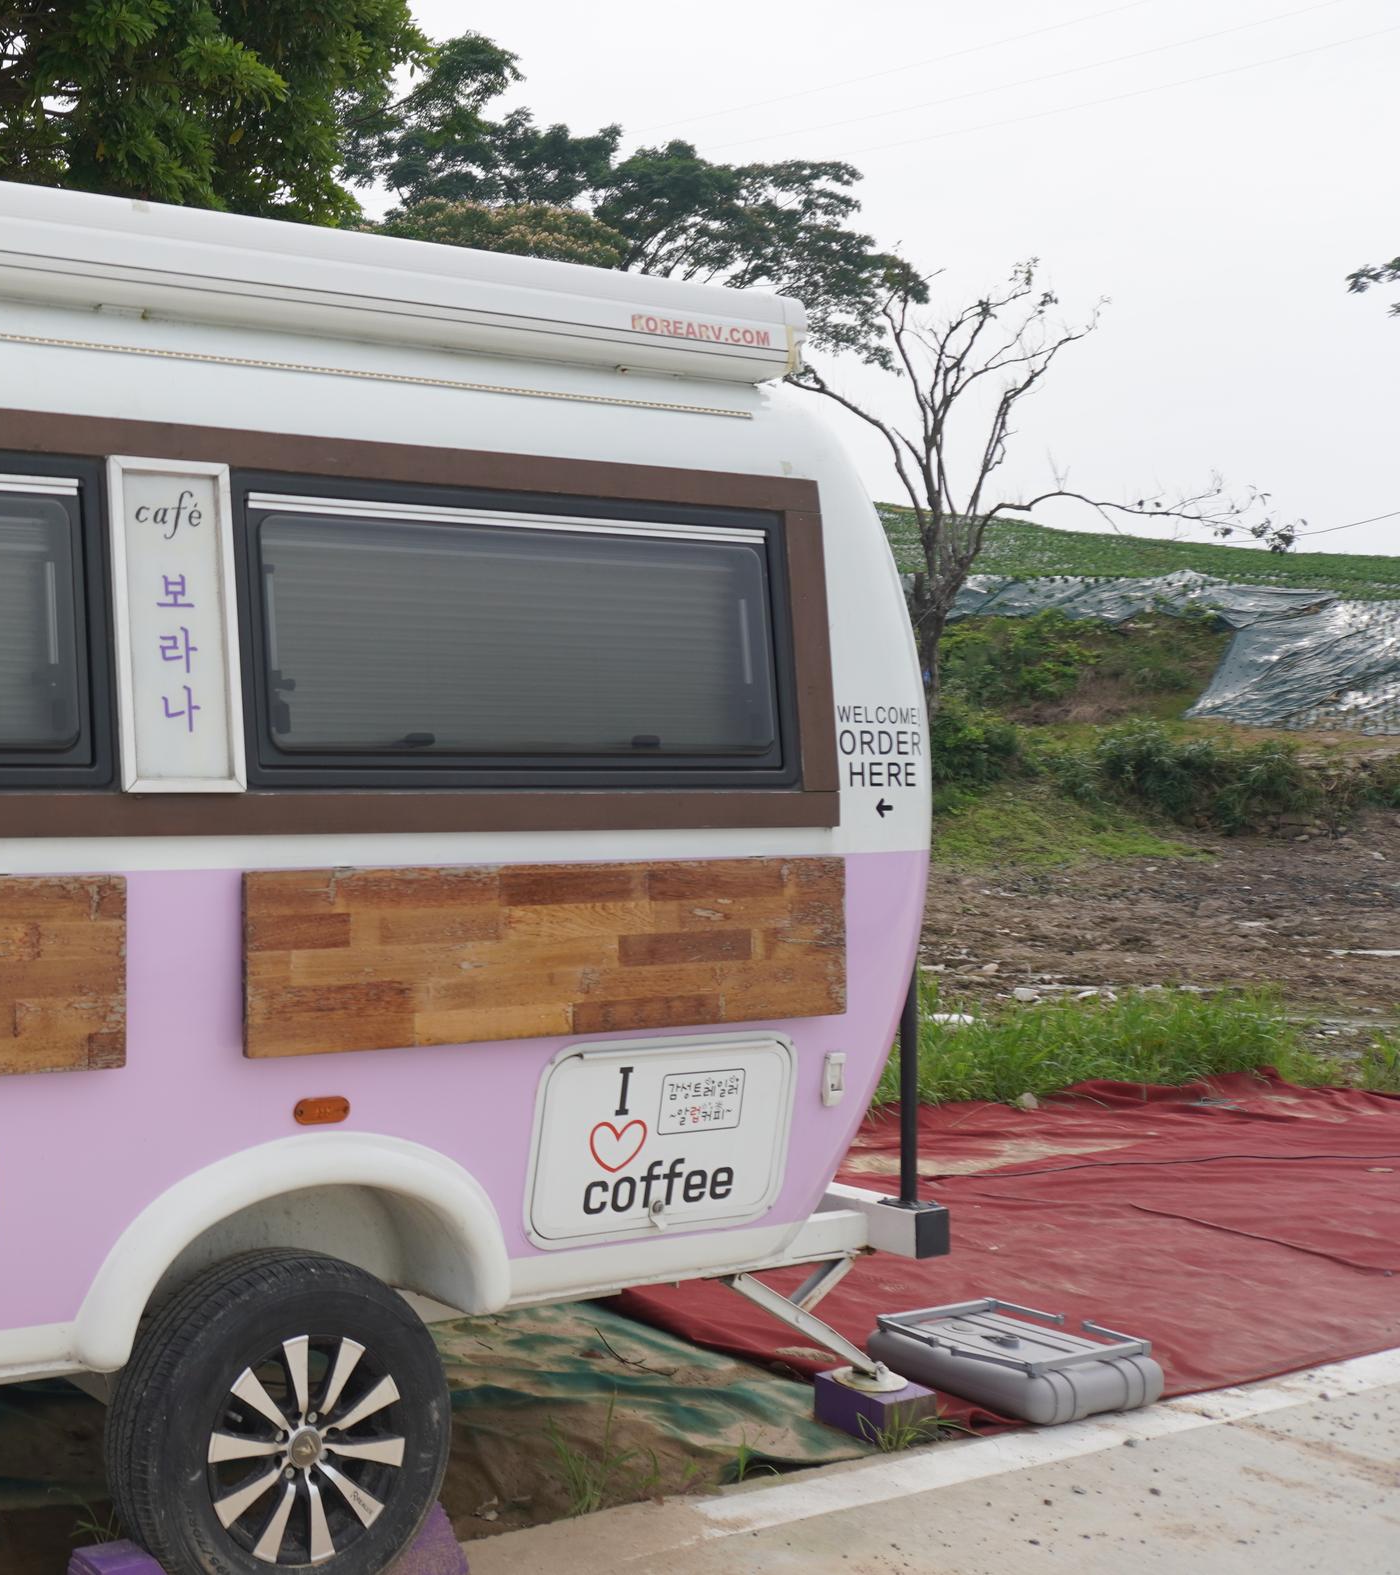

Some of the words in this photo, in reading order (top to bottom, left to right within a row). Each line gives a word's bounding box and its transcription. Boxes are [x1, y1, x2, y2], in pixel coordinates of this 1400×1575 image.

[135, 490, 202, 540] café
[156, 573, 201, 733] 보라나
[839, 729, 922, 756] ORDER
[849, 762, 916, 787] HERE
[614, 1066, 634, 1116] I
[582, 1158, 734, 1215] coffee
